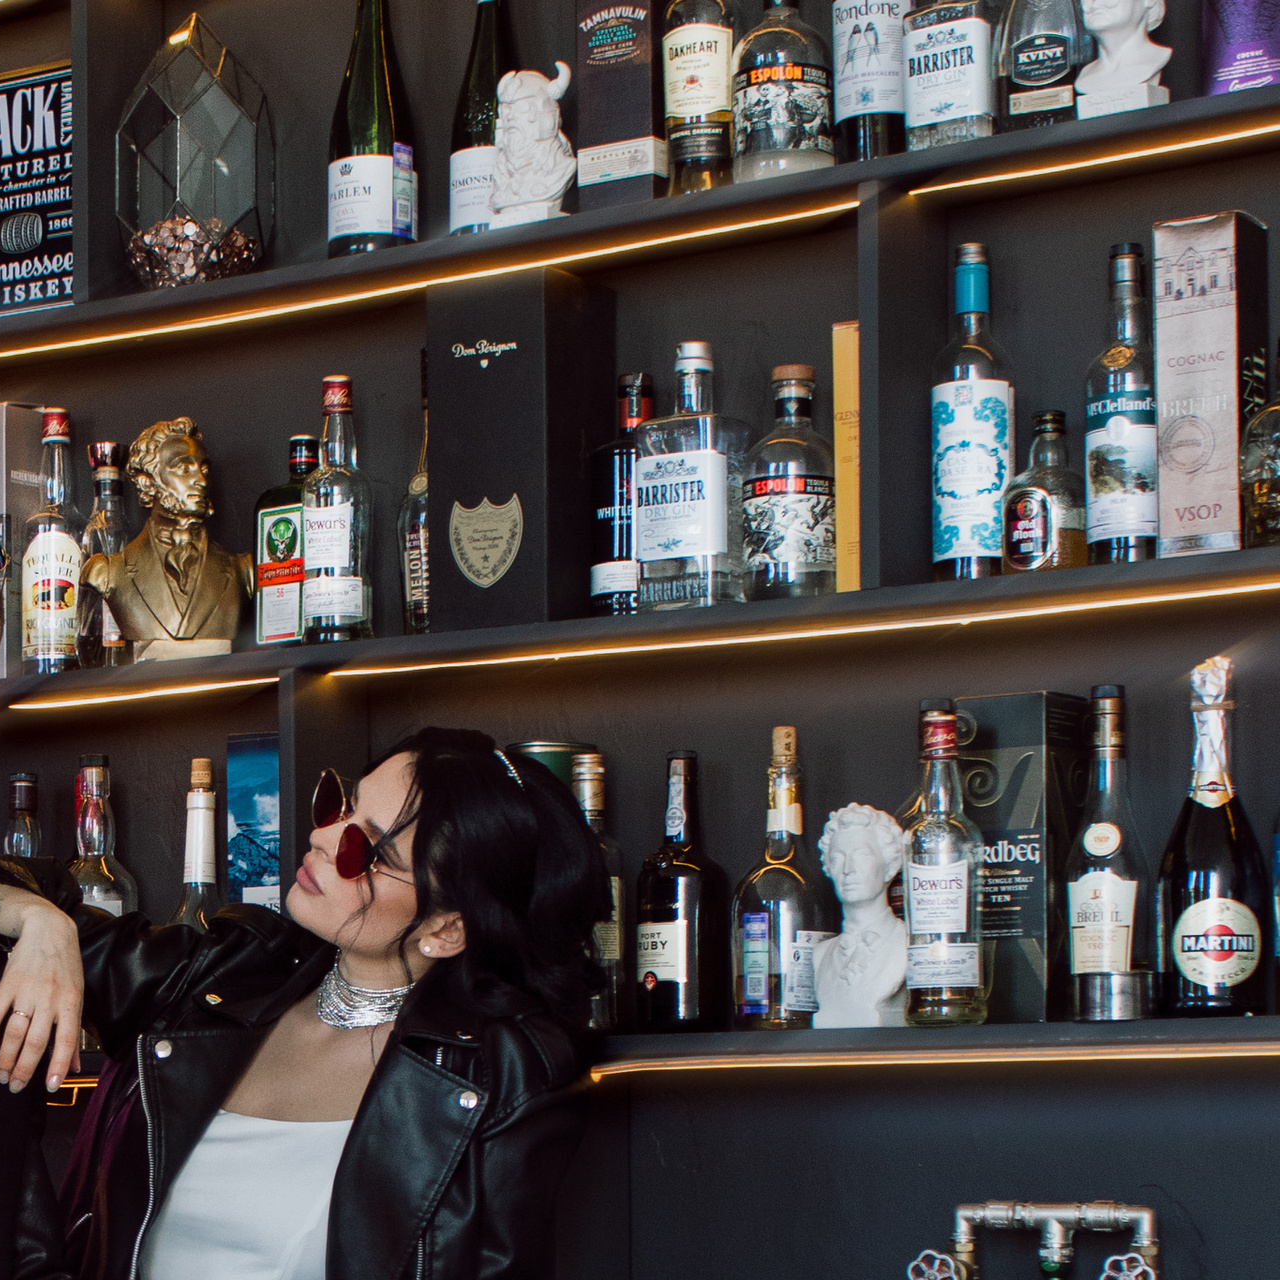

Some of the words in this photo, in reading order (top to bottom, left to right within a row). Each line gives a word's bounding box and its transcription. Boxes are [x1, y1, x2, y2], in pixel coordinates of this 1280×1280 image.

[579, 5, 648, 32] TAMNAVULIN
[834, 0, 901, 25] Rondone
[668, 40, 719, 61] OAKHEART
[1017, 46, 1065, 64] KVINT
[907, 45, 975, 78] BARRISTER
[803, 67, 826, 78] TEQUILA
[917, 74, 939, 88] DRY
[943, 67, 967, 82] GIN
[3, 176, 46, 194] character
[46, 173, 57, 184] in
[34, 186, 73, 206] BARREL
[452, 342, 476, 358] Dom
[476, 339, 518, 357] Pérignon
[1167, 351, 1226, 368] COGNAC
[946, 456, 983, 467] CASL
[806, 478, 829, 487] TEQUILA
[806, 485, 829, 494] BLANCO
[637, 479, 706, 508] BARRISTER
[644, 506, 669, 519] DRY
[672, 503, 697, 517] GIN
[1175, 503, 1223, 522] VSOP
[306, 517, 346, 532] Dewar's
[409, 549, 424, 601] MELON
[276, 588, 285, 598] 56
[983, 840, 1041, 864] rdbeg
[912, 876, 964, 892] Dewar's
[988, 877, 1013, 886] SINGLE
[1000, 884, 1029, 892] WHISKY
[990, 894, 1012, 903] TEN
[1080, 902, 1118, 912] GRAD
[641, 932, 662, 940] PORT
[1182, 935, 1254, 951] MARTINI
[638, 940, 668, 951] RUBY
[1087, 942, 1108, 950] VSO
[1192, 967, 1246, 980] PRSECCO
